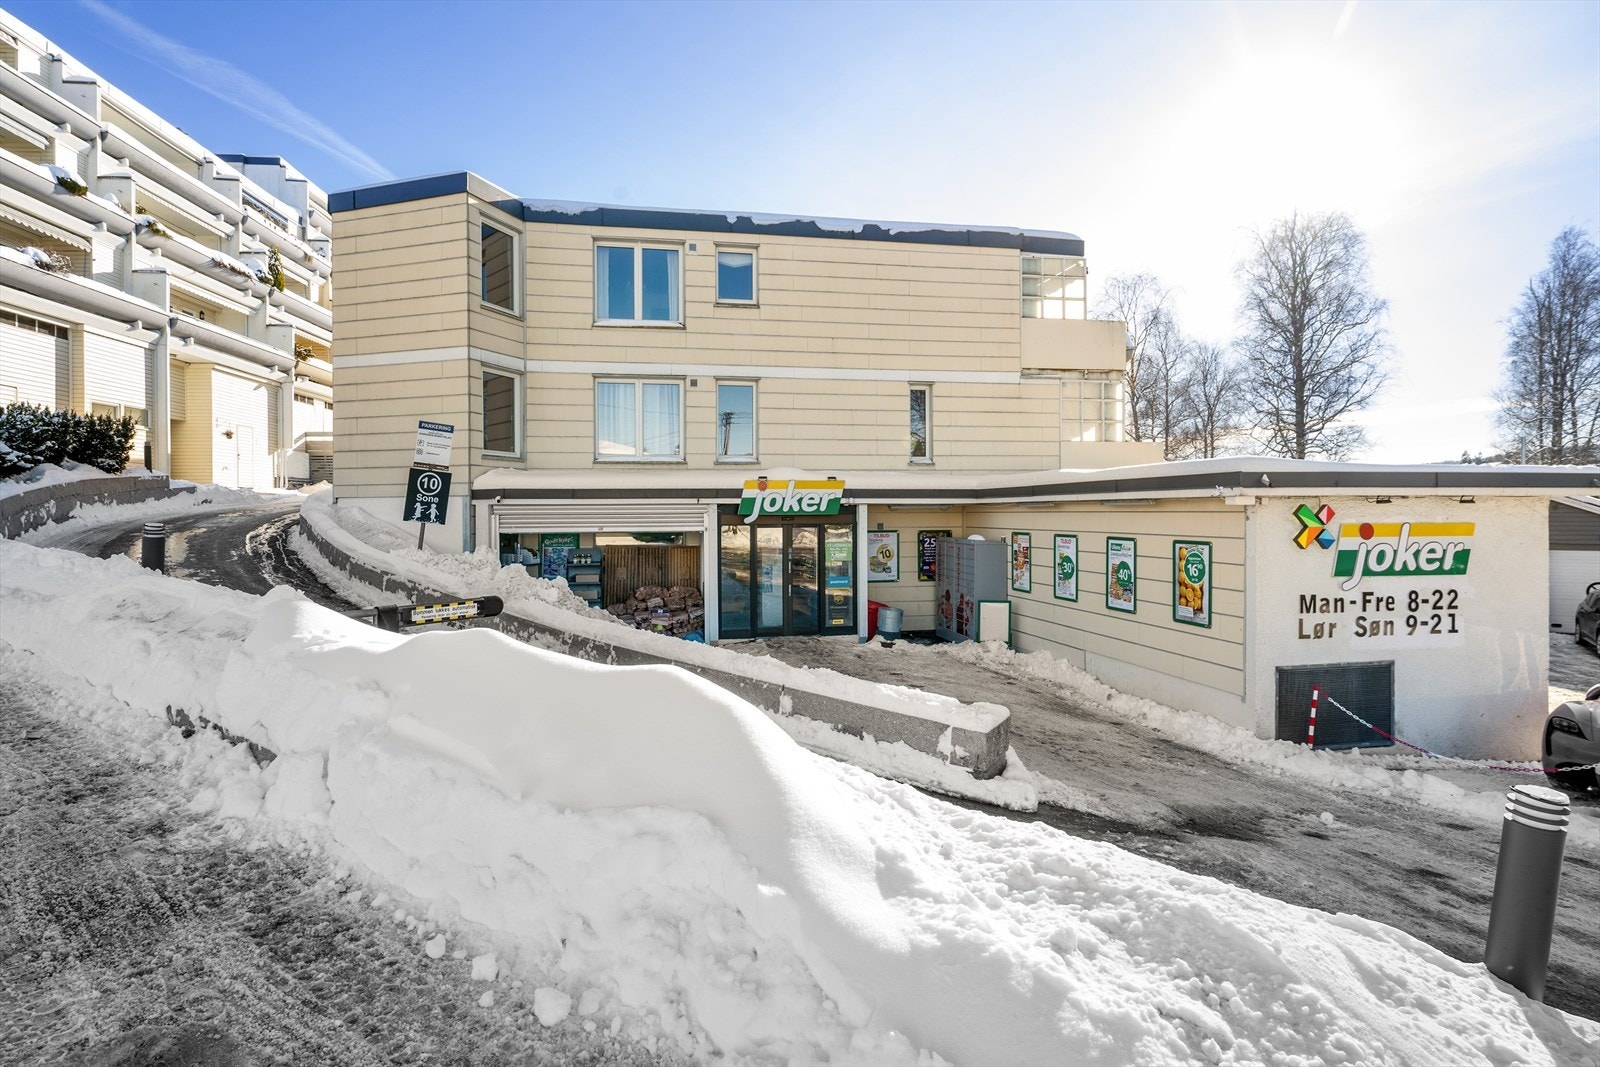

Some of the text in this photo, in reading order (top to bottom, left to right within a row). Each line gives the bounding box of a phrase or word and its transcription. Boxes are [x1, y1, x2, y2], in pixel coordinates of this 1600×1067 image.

[421, 422, 452, 431] PARKERING
[421, 476, 438, 490] 10
[416, 493, 439, 503] Sone
[743, 479, 836, 524] joker
[880, 549, 891, 560] 10
[1341, 522, 1465, 591] joker
[1299, 589, 1459, 614] Man-Fre 8-22
[1298, 613, 1459, 640] Lør Søn 9-21
